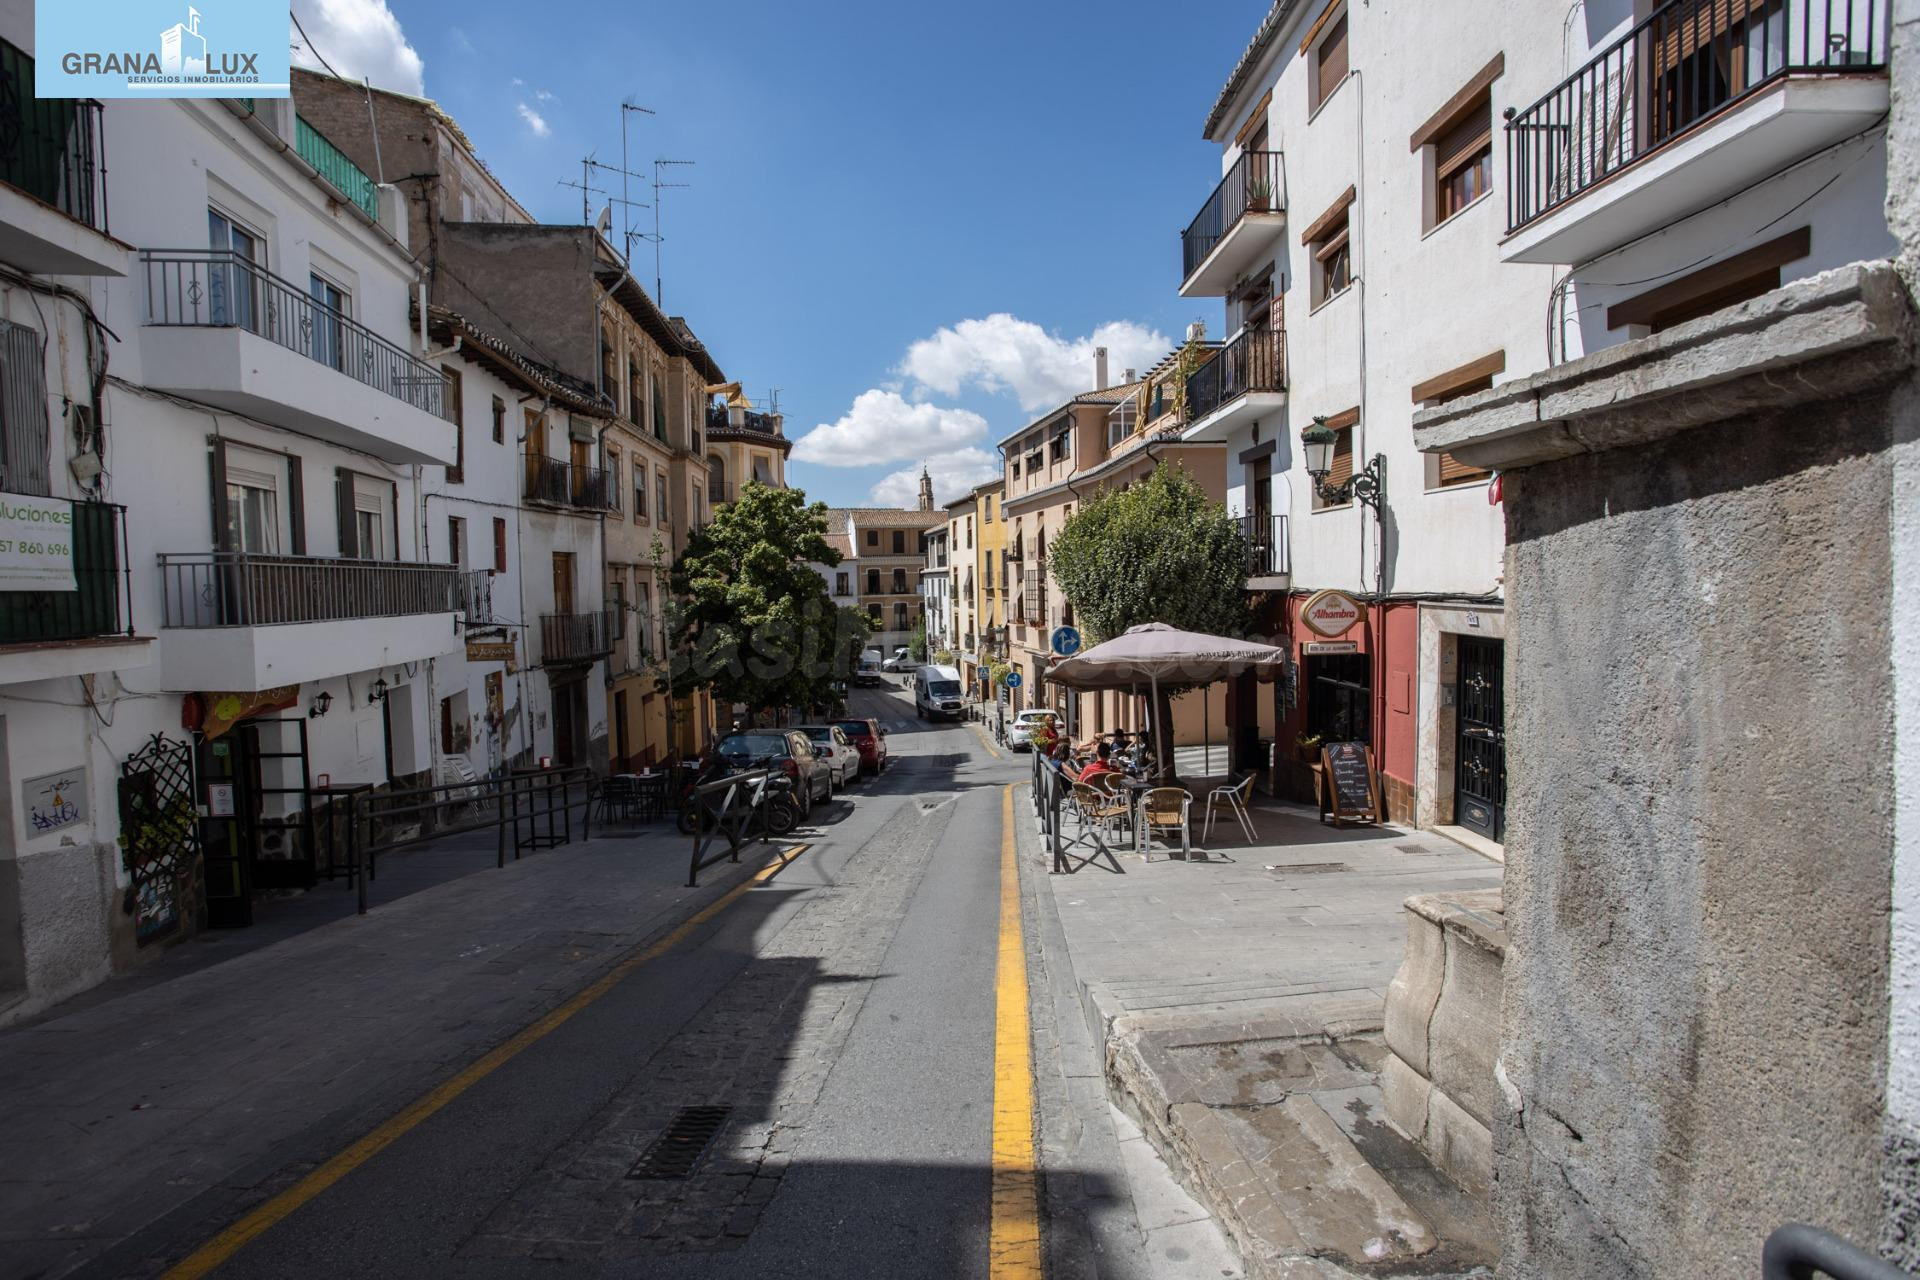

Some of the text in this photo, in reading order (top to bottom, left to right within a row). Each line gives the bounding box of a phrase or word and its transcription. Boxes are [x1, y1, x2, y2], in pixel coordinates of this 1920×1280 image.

[0, 502, 72, 525] luciones
[18, 541, 44, 555] 860
[47, 543, 70, 556] 696
[1312, 608, 1356, 619] Alhambra
